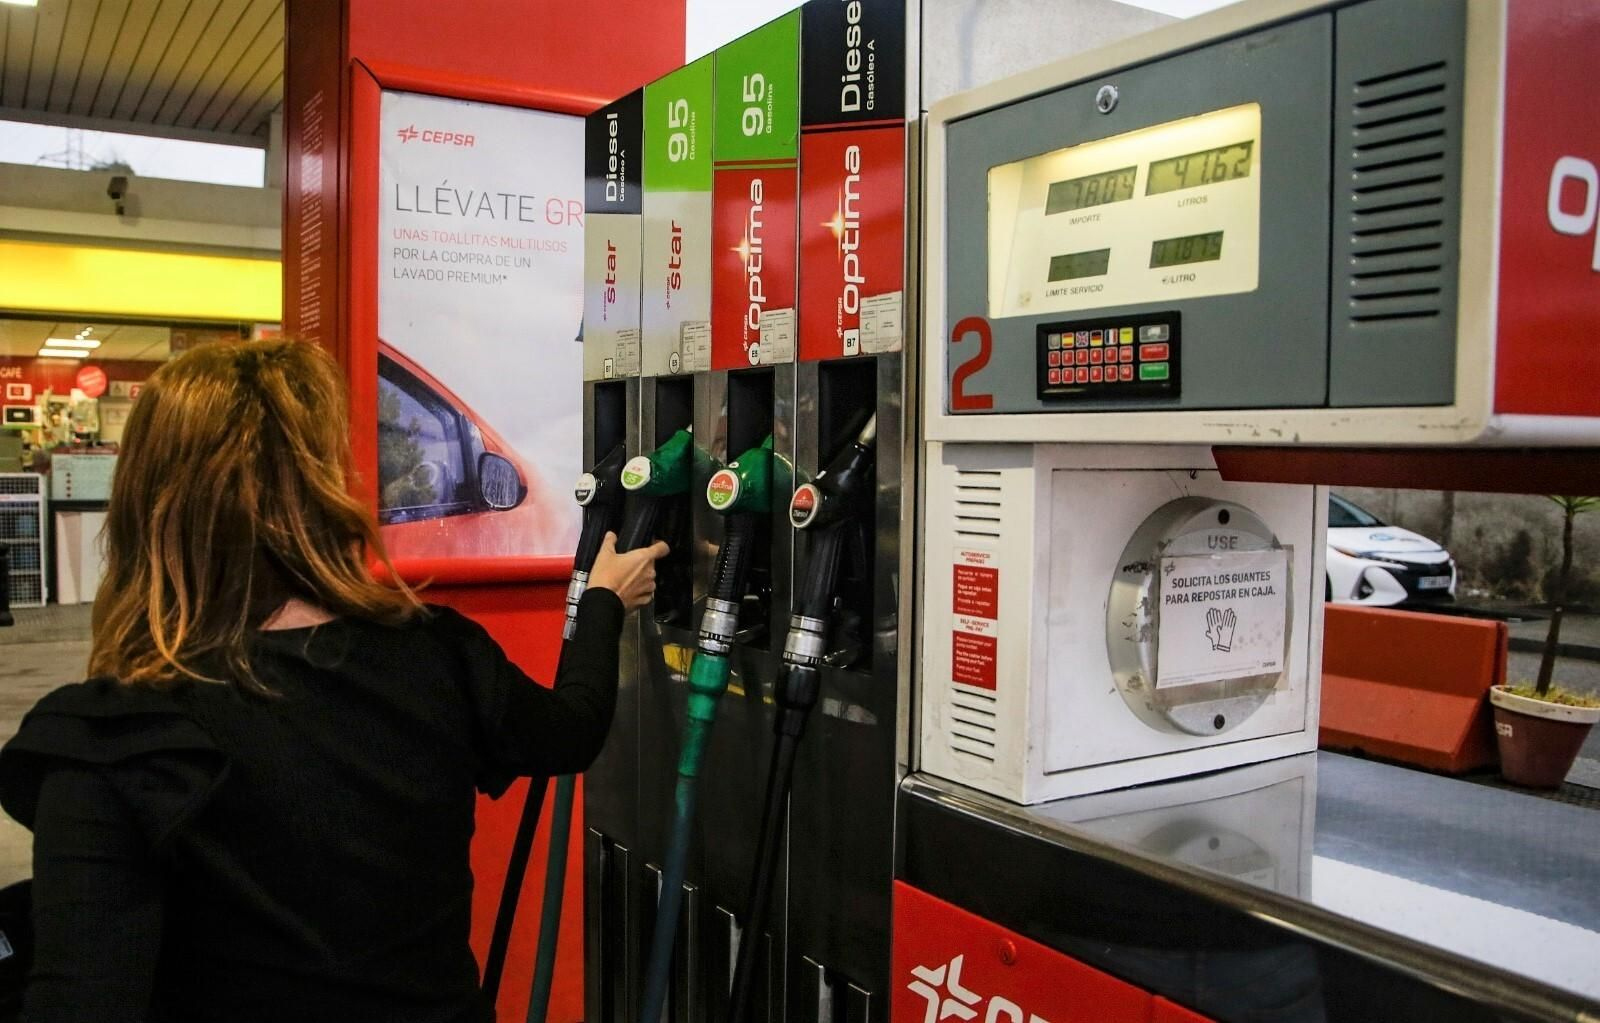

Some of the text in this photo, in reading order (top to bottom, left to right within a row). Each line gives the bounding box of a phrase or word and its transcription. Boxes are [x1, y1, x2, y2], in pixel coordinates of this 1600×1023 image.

[841, 0, 861, 113] Diese
[866, 39, 875, 111] Gasóleo A
[741, 73, 765, 137] 95
[765, 83, 773, 134] Gasolina
[422, 130, 475, 147] CEPSA
[668, 98, 689, 162] 95
[605, 113, 618, 202] Diesel
[395, 179, 584, 228] LLÉVATE GR
[1069, 213, 1101, 225] IMPORTE
[1177, 195, 1208, 207] LITROS
[1547, 155, 1600, 273] o
[393, 228, 568, 253] UNAS TOALLITAS MULTIUSOS
[841, 144, 865, 315] optima
[393, 247, 531, 269] POR LA COMPRA DE UN
[605, 240, 617, 304] star
[668, 220, 682, 291] star
[747, 178, 767, 331] optima
[393, 267, 444, 282] LAVADO
[1070, 284, 1104, 296] SERVICIO
[751, 350, 758, 358] E5
[846, 337, 856, 348] B7
[951, 315, 993, 411] 2
[713, 493, 725, 502] 95
[1207, 535, 1238, 550] USE
[1165, 585, 1276, 605] PARA REPOSTAR EN CAJA.
[1172, 571, 1271, 589] SOLICITA LOS GUANTES
